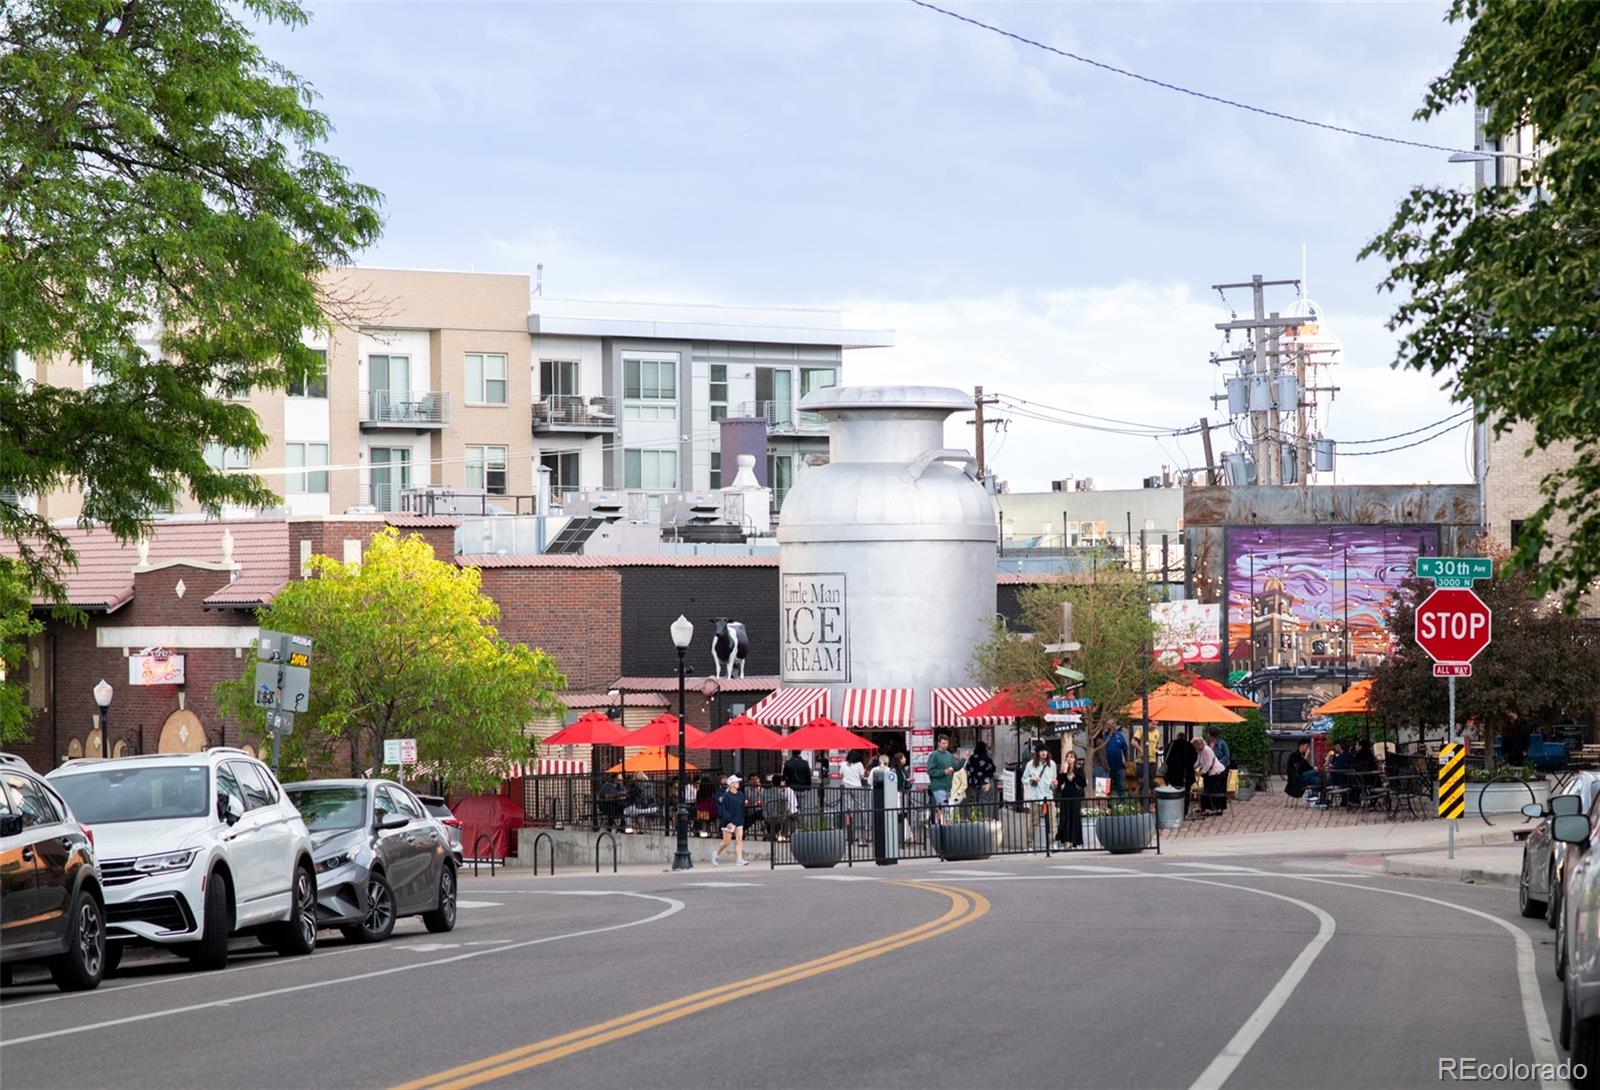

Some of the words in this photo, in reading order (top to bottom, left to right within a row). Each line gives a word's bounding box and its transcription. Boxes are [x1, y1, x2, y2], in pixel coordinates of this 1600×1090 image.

[1434, 561, 1470, 575] 30th
[785, 582, 808, 604] Little
[810, 583, 841, 604] Man
[785, 606, 842, 646] ICE
[1421, 612, 1486, 640] STOP
[784, 647, 842, 672] CREAM
[1436, 666, 1450, 674] ALL
[1453, 666, 1469, 674] WAY
